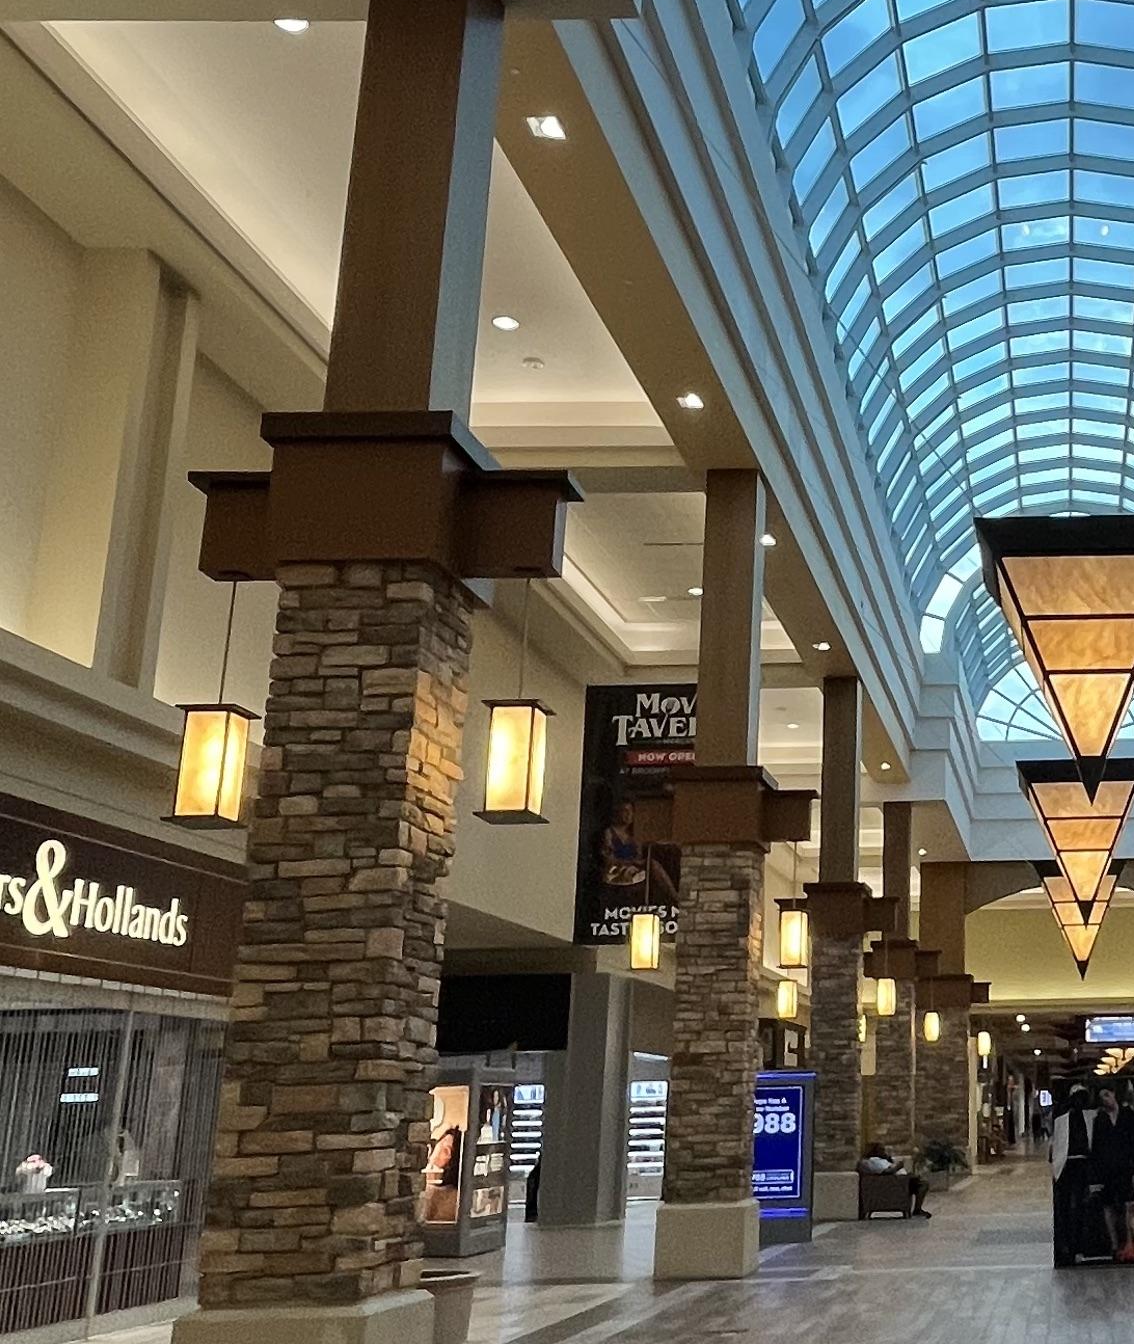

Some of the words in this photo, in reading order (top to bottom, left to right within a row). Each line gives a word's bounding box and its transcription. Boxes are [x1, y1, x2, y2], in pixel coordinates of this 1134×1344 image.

[635, 692, 698, 717] MOV
[612, 715, 697, 746] TAVE
[23, 839, 74, 938] &
[70, 878, 188, 947] Hollands
[590, 922, 630, 936] TAST
